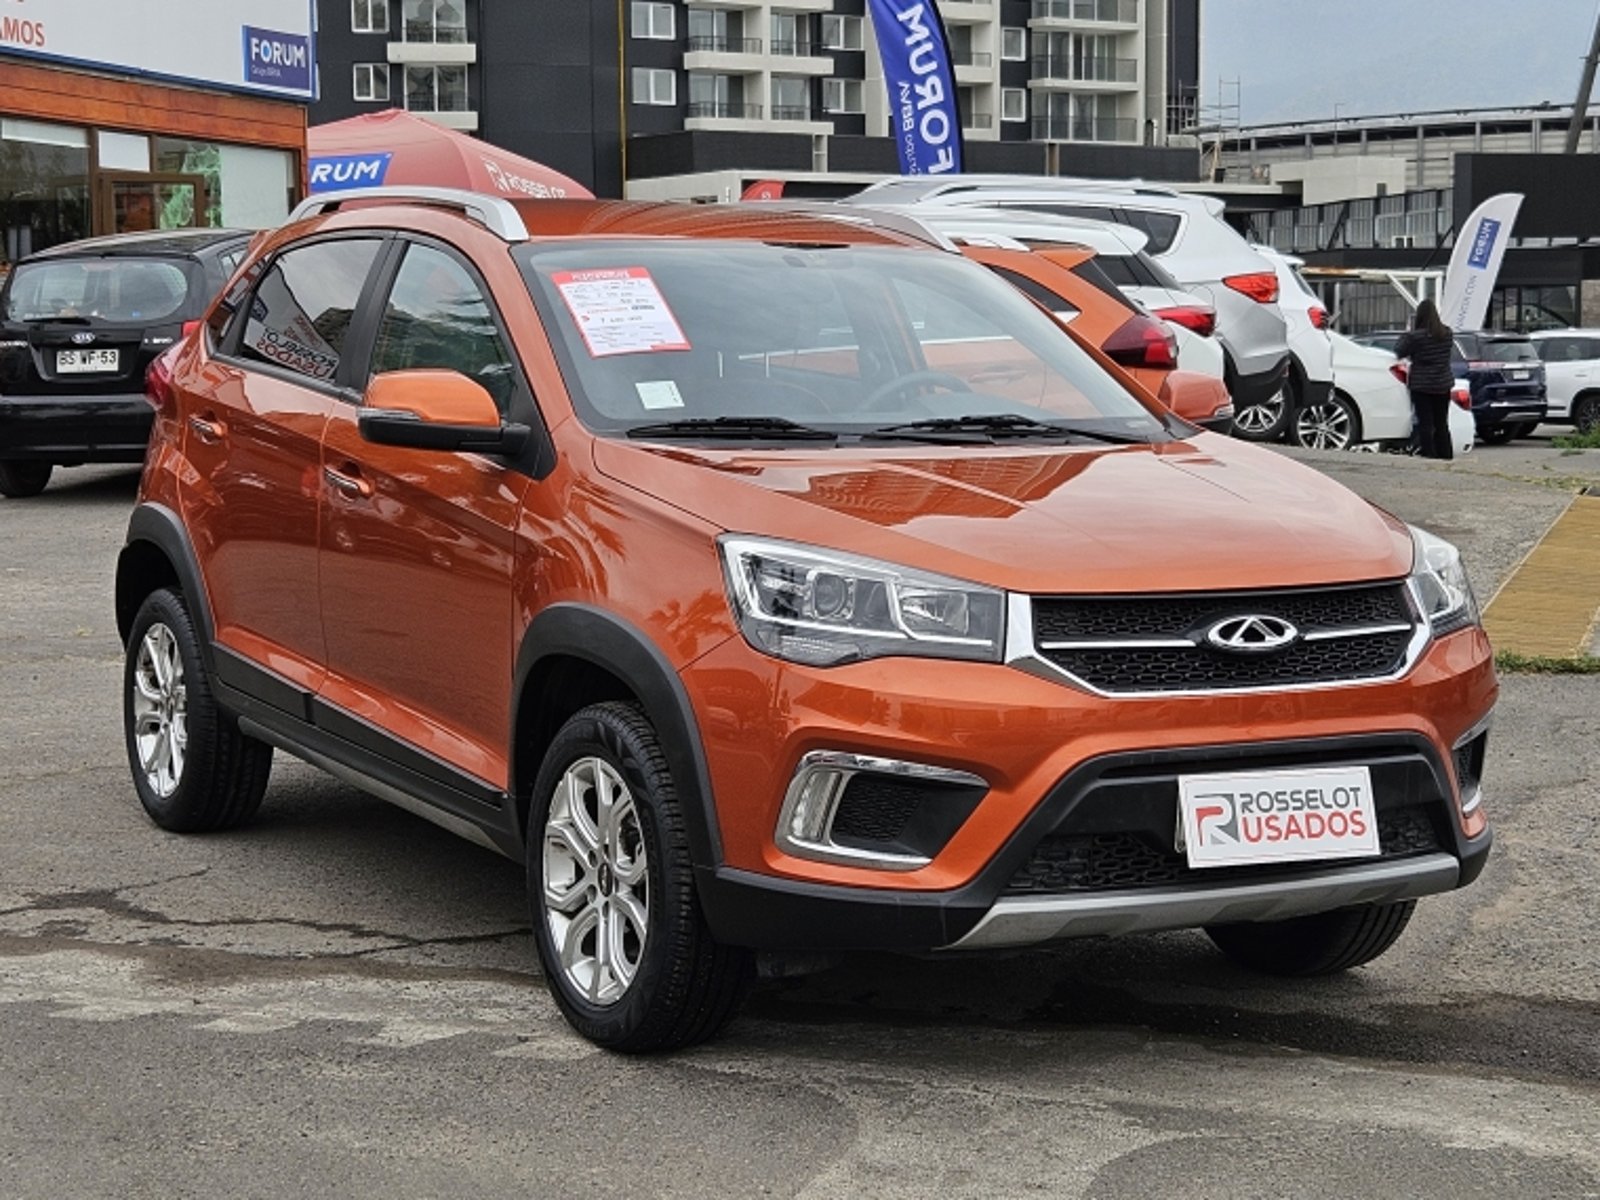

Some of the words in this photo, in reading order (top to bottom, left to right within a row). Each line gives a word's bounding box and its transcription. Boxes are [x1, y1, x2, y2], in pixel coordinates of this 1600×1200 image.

[0, 16, 45, 47] MOS
[250, 37, 306, 68] FORUM
[1239, 787, 1361, 814] ROSSELOT
[1242, 810, 1367, 843] USADOS
